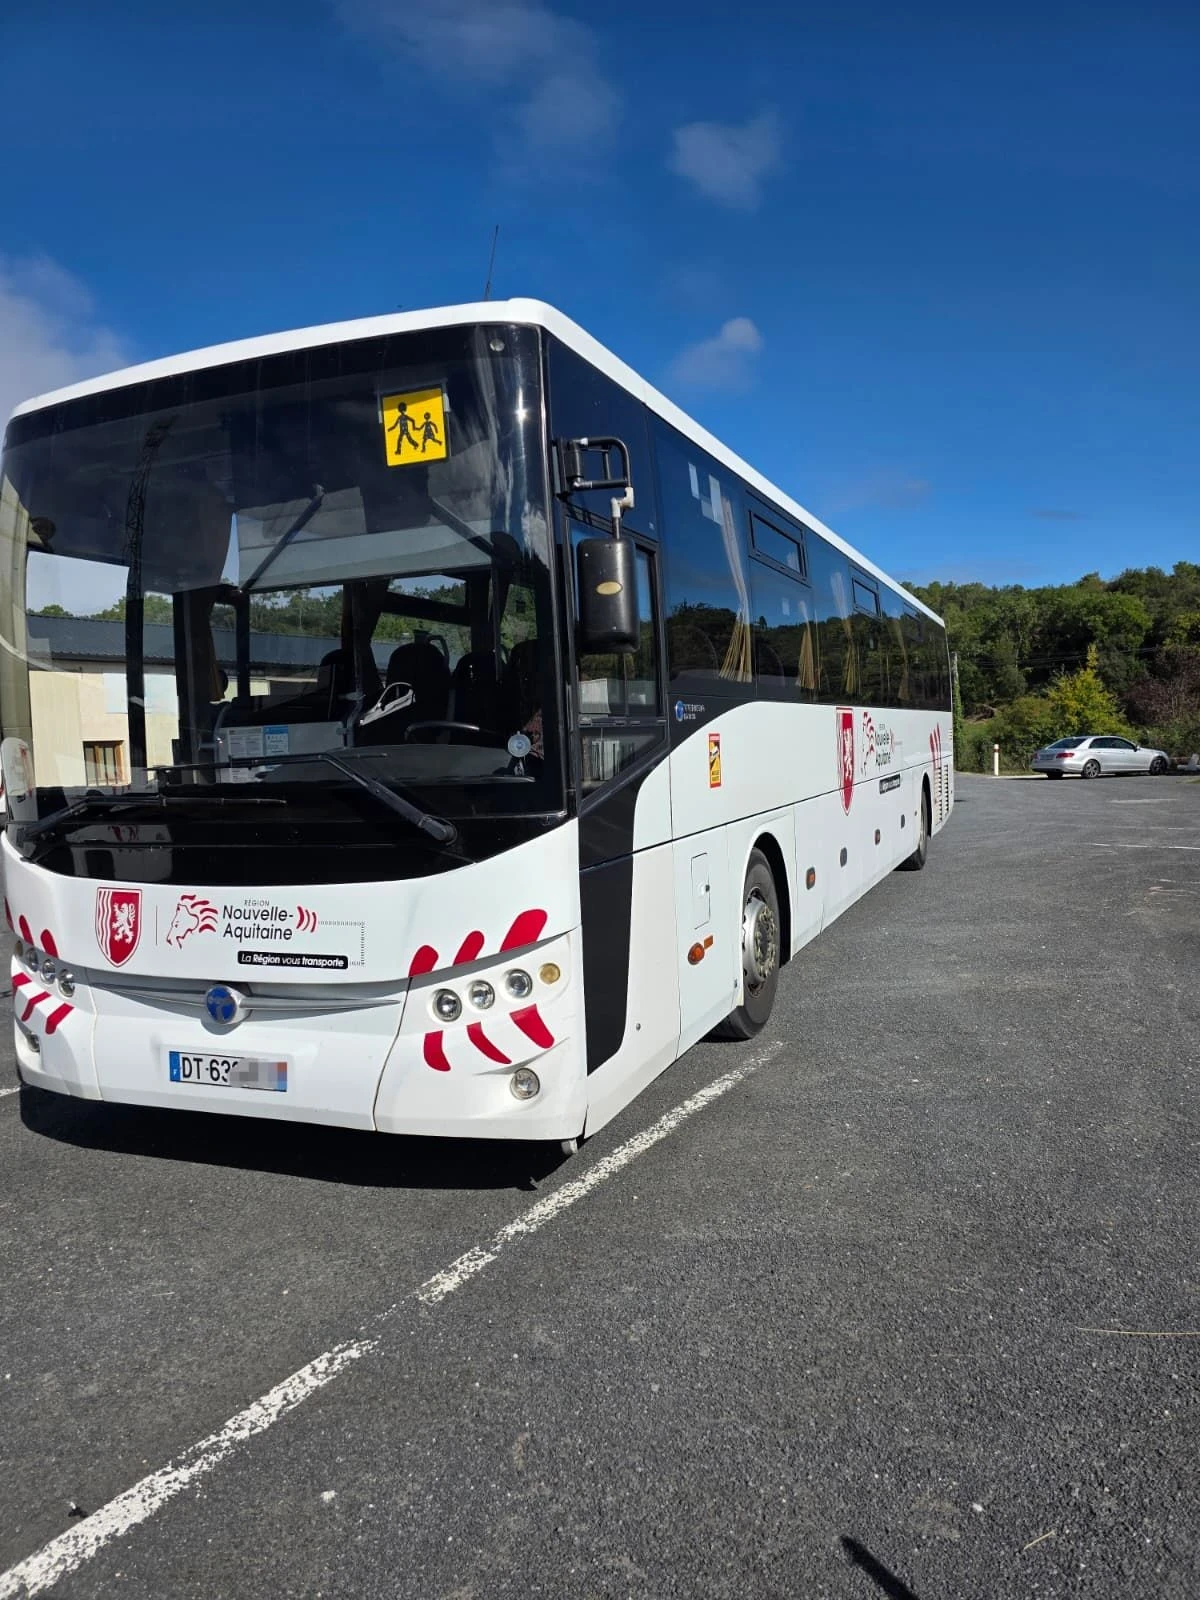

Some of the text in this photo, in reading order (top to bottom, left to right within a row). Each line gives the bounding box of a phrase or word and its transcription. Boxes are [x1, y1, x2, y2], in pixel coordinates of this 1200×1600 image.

[222, 904, 294, 922] Nouvelle-
[223, 922, 293, 943] Aquitaine
[241, 953, 345, 968] La Région vous transporte
